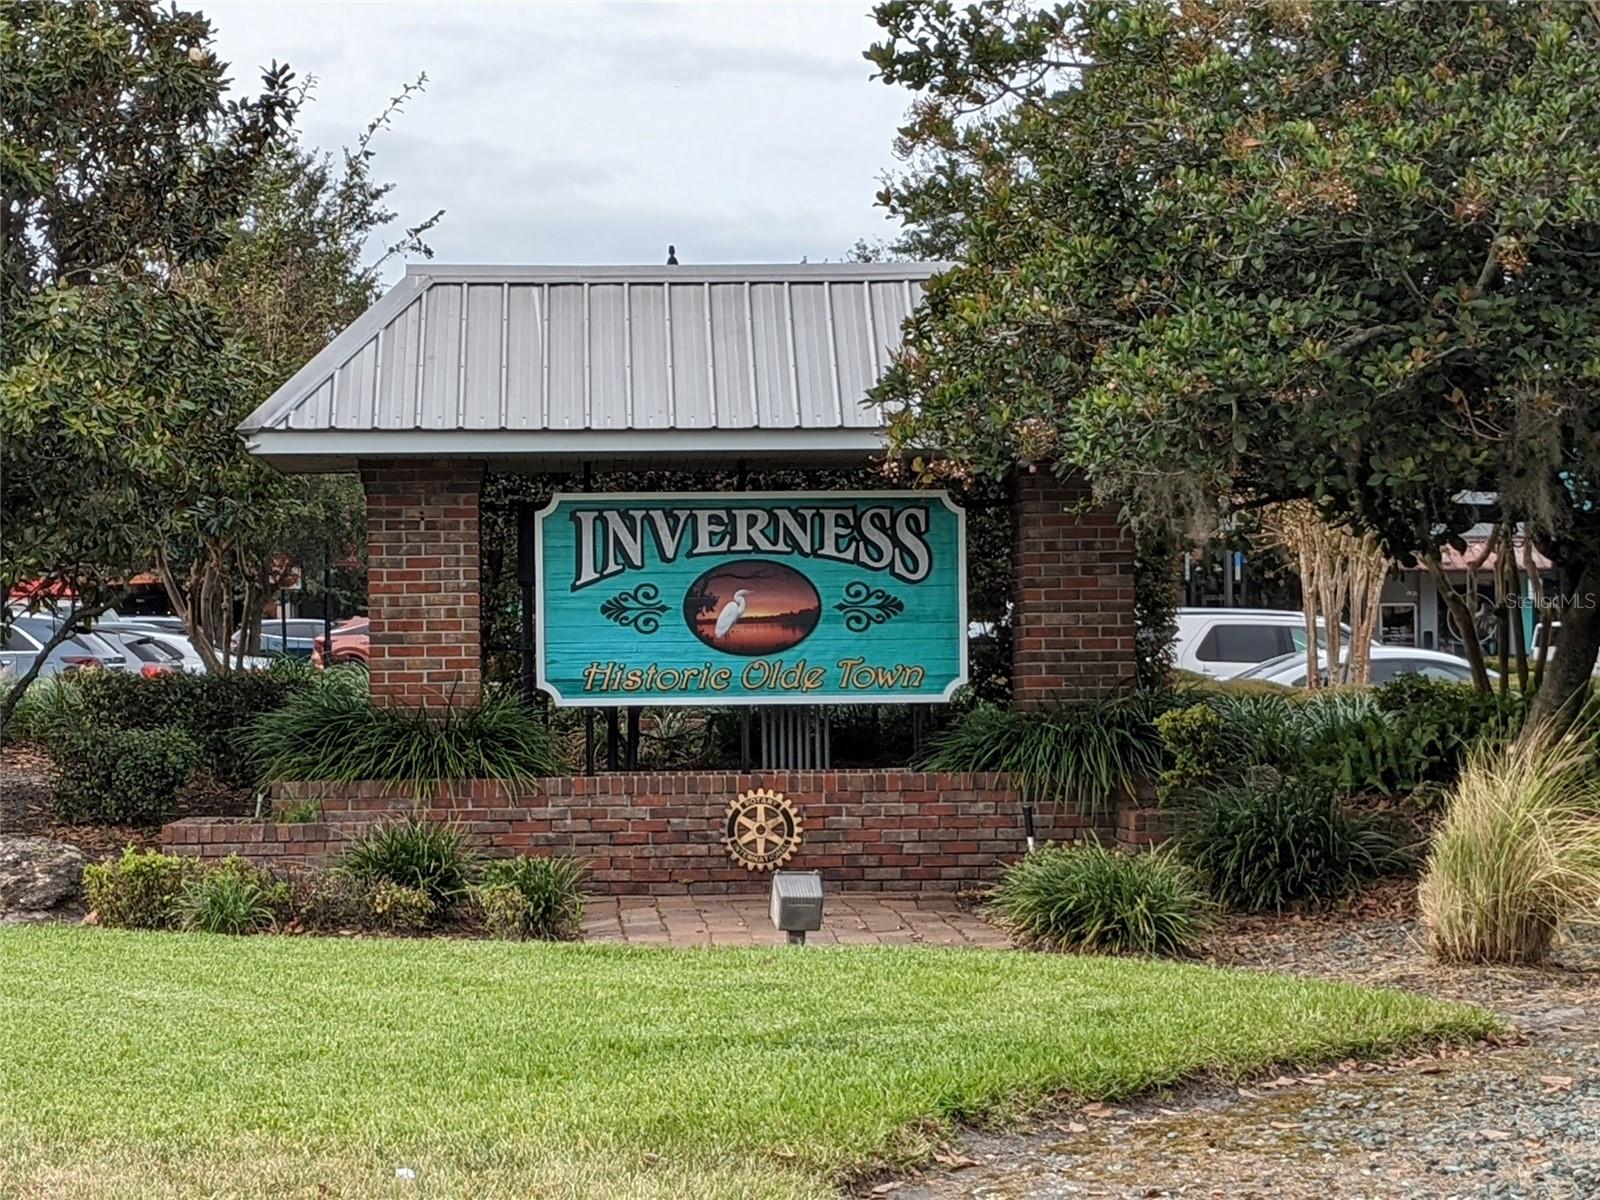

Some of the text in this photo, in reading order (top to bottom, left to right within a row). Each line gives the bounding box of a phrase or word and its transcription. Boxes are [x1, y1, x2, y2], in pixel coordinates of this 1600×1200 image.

[571, 506, 932, 590] INVERNESS
[583, 656, 924, 692] Historic Olde Town
